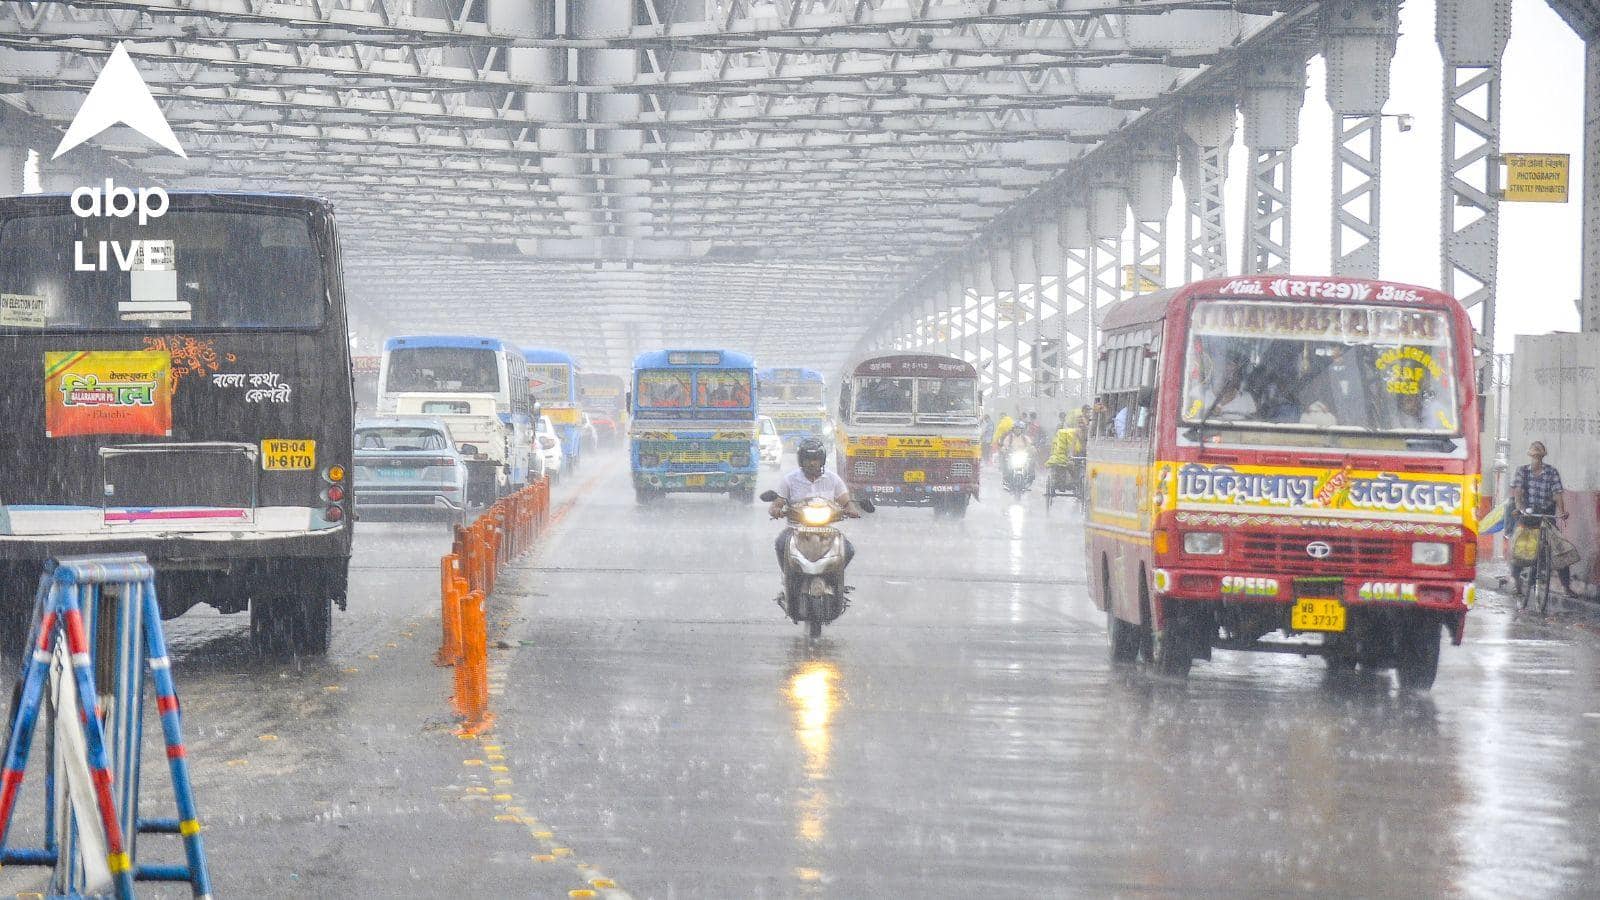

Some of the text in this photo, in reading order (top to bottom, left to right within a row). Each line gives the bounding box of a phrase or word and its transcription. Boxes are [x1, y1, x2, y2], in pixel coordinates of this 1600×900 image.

[1516, 171, 1560, 181] PHOTOGRAPHY
[212, 371, 280, 388] বলো কথা
[245, 383, 292, 403] কেশরী
[1220, 575, 1280, 596] SPEED
[1301, 603, 1336, 614] WB 11
[1312, 615, 1339, 626] 3737
